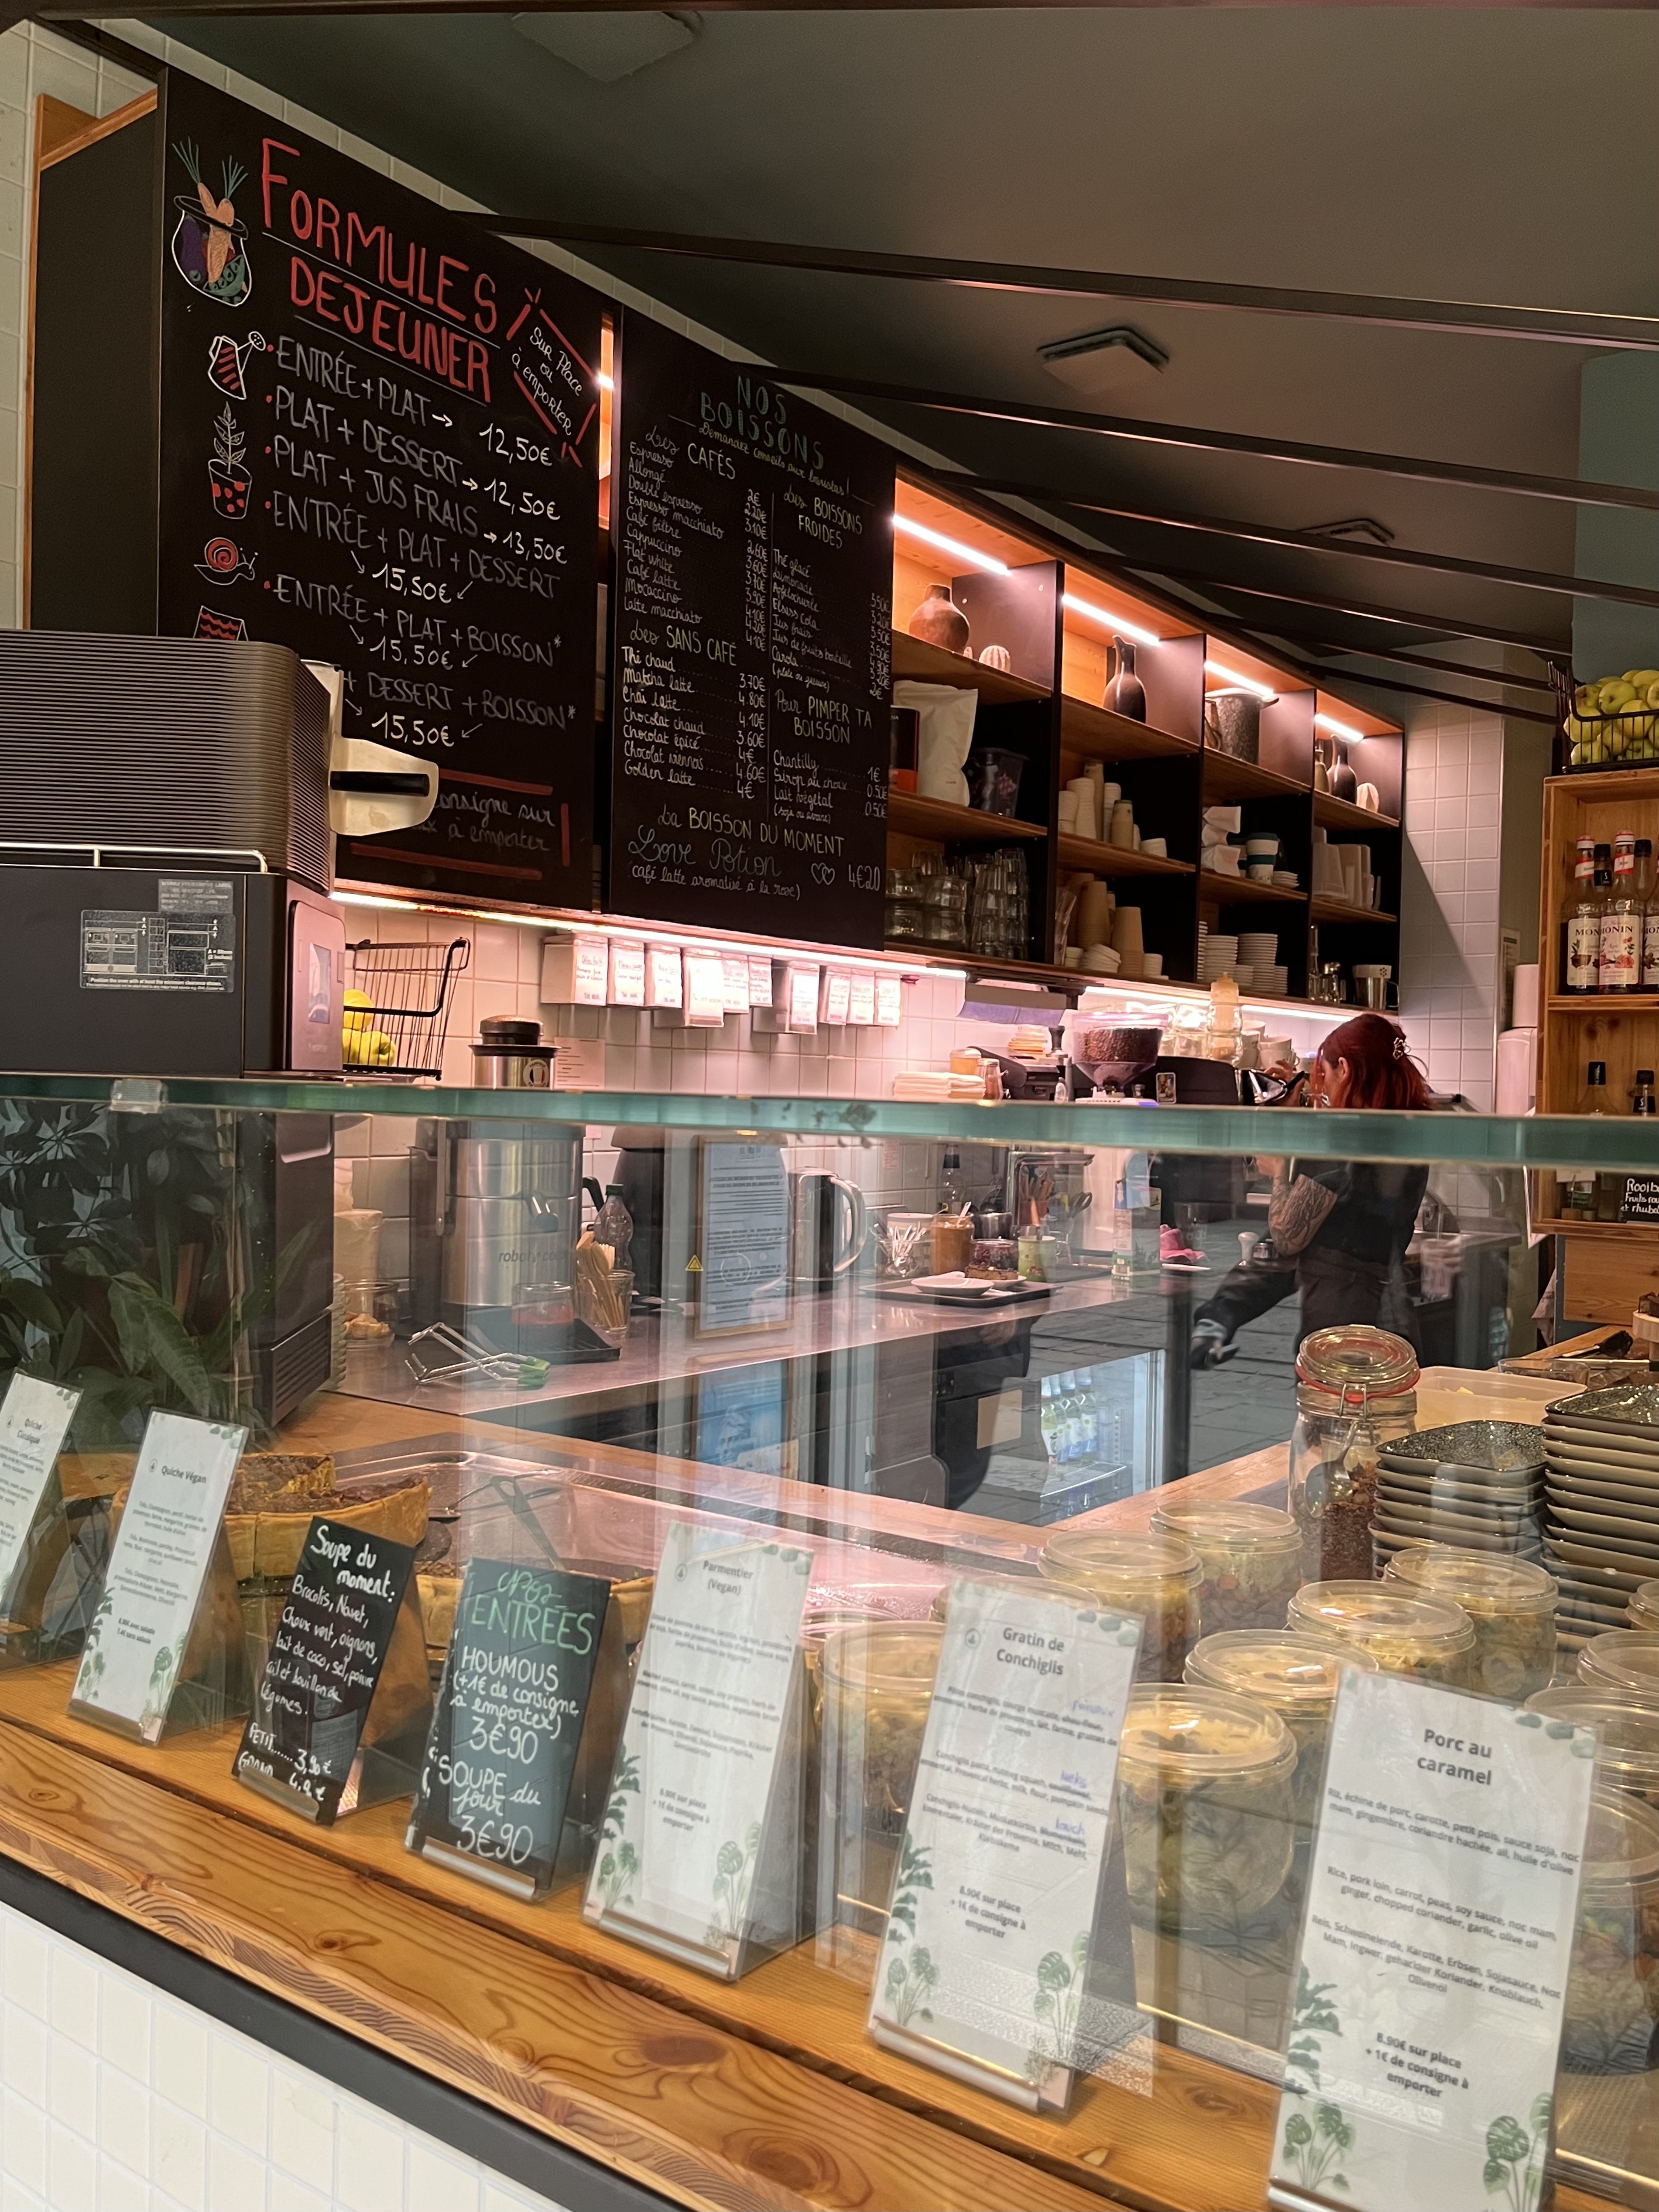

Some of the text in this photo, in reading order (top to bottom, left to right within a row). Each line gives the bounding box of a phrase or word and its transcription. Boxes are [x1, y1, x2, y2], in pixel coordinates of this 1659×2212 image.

[263, 138, 497, 333] FORMULES
[291, 257, 491, 403] DEJEUNER
[540, 363, 553, 383] ou
[738, 375, 786, 424] NOS
[479, 424, 553, 467] 12,50€
[701, 392, 824, 469] BOISSONS
[276, 386, 560, 520] PLAT DESSERT 12,50€
[630, 441, 674, 468] Espresso
[688, 443, 735, 479] CAFÉS
[629, 457, 666, 489] Allongé
[274, 435, 567, 564] PLAT JUS FRAIS 13,50€
[629, 475, 703, 514] Double espresso
[626, 506, 649, 527] Café
[629, 491, 724, 539] Espresso macchiato
[798, 515, 842, 549] FROIDES
[814, 497, 862, 534] BOISSONS
[273, 491, 560, 598] ENTRÉE PLAT DESSERT
[627, 523, 682, 557] Cappuccino
[773, 548, 789, 568] Thé
[372, 563, 452, 603] 15,50€
[273, 574, 371, 623] ENTRÉE
[397, 610, 447, 646] PLAT
[369, 640, 453, 670] 15,50€
[621, 646, 642, 664] Thé
[645, 651, 676, 672] chaud
[666, 625, 702, 654] SANS
[707, 638, 738, 666] CAFÉ
[368, 672, 454, 710] DESSERT
[623, 667, 665, 687] Matcha
[670, 674, 695, 693] latte
[652, 691, 681, 711] latte
[808, 695, 850, 724] PIMPER
[855, 708, 872, 729] TA
[371, 712, 454, 746] 15,50€
[623, 707, 670, 728] Chocolat
[674, 716, 706, 735] chaud
[794, 716, 850, 745] BOISSON
[623, 725, 756, 764] Chocolat épicé 4€
[624, 740, 665, 764] Chocolat
[625, 759, 755, 799] Golden latte 4€
[773, 749, 881, 783] Chantilly 1€
[774, 768, 805, 793] Sirop
[518, 804, 556, 826] sur
[689, 807, 752, 839] BOISSON
[760, 822, 779, 844] DU
[784, 828, 845, 857] MOMENT
[628, 825, 880, 891] Love Potion 4€20
[660, 866, 743, 890] latte aromatisé
[1631, 1203, 1659, 1214] rhuba
[310, 1525, 377, 1569] Soupe du
[703, 1561, 753, 1579] Parmentier
[282, 1606, 311, 1632] Choux
[293, 1641, 305, 1657] de
[1003, 1627, 1065, 1652] Gratin de
[461, 1645, 559, 1692] HOUMOUS
[996, 1648, 1064, 1675] Conchiglis
[450, 1690, 467, 1707] à
[491, 1678, 508, 1699] de
[513, 1686, 580, 1723] consigne
[468, 1716, 539, 1765] 3€90
[1424, 1729, 1492, 1758] Porc au
[438, 1755, 541, 1806] SOUPE du
[1417, 1756, 1492, 1785] caramel
[457, 1814, 533, 1865] 3€90
[1376, 1801, 1387, 1811] de
[1504, 1837, 1532, 1850] sauce
[998, 1899, 1020, 1913] place
[1350, 1874, 1472, 1917] pork soy
[1374, 1895, 1414, 1912] chopped
[1390, 2055, 1458, 2085] de consigne
[1409, 2045, 1428, 2056] sur
[1430, 2052, 1461, 2068] place
[1387, 2073, 1442, 2097] emporter
